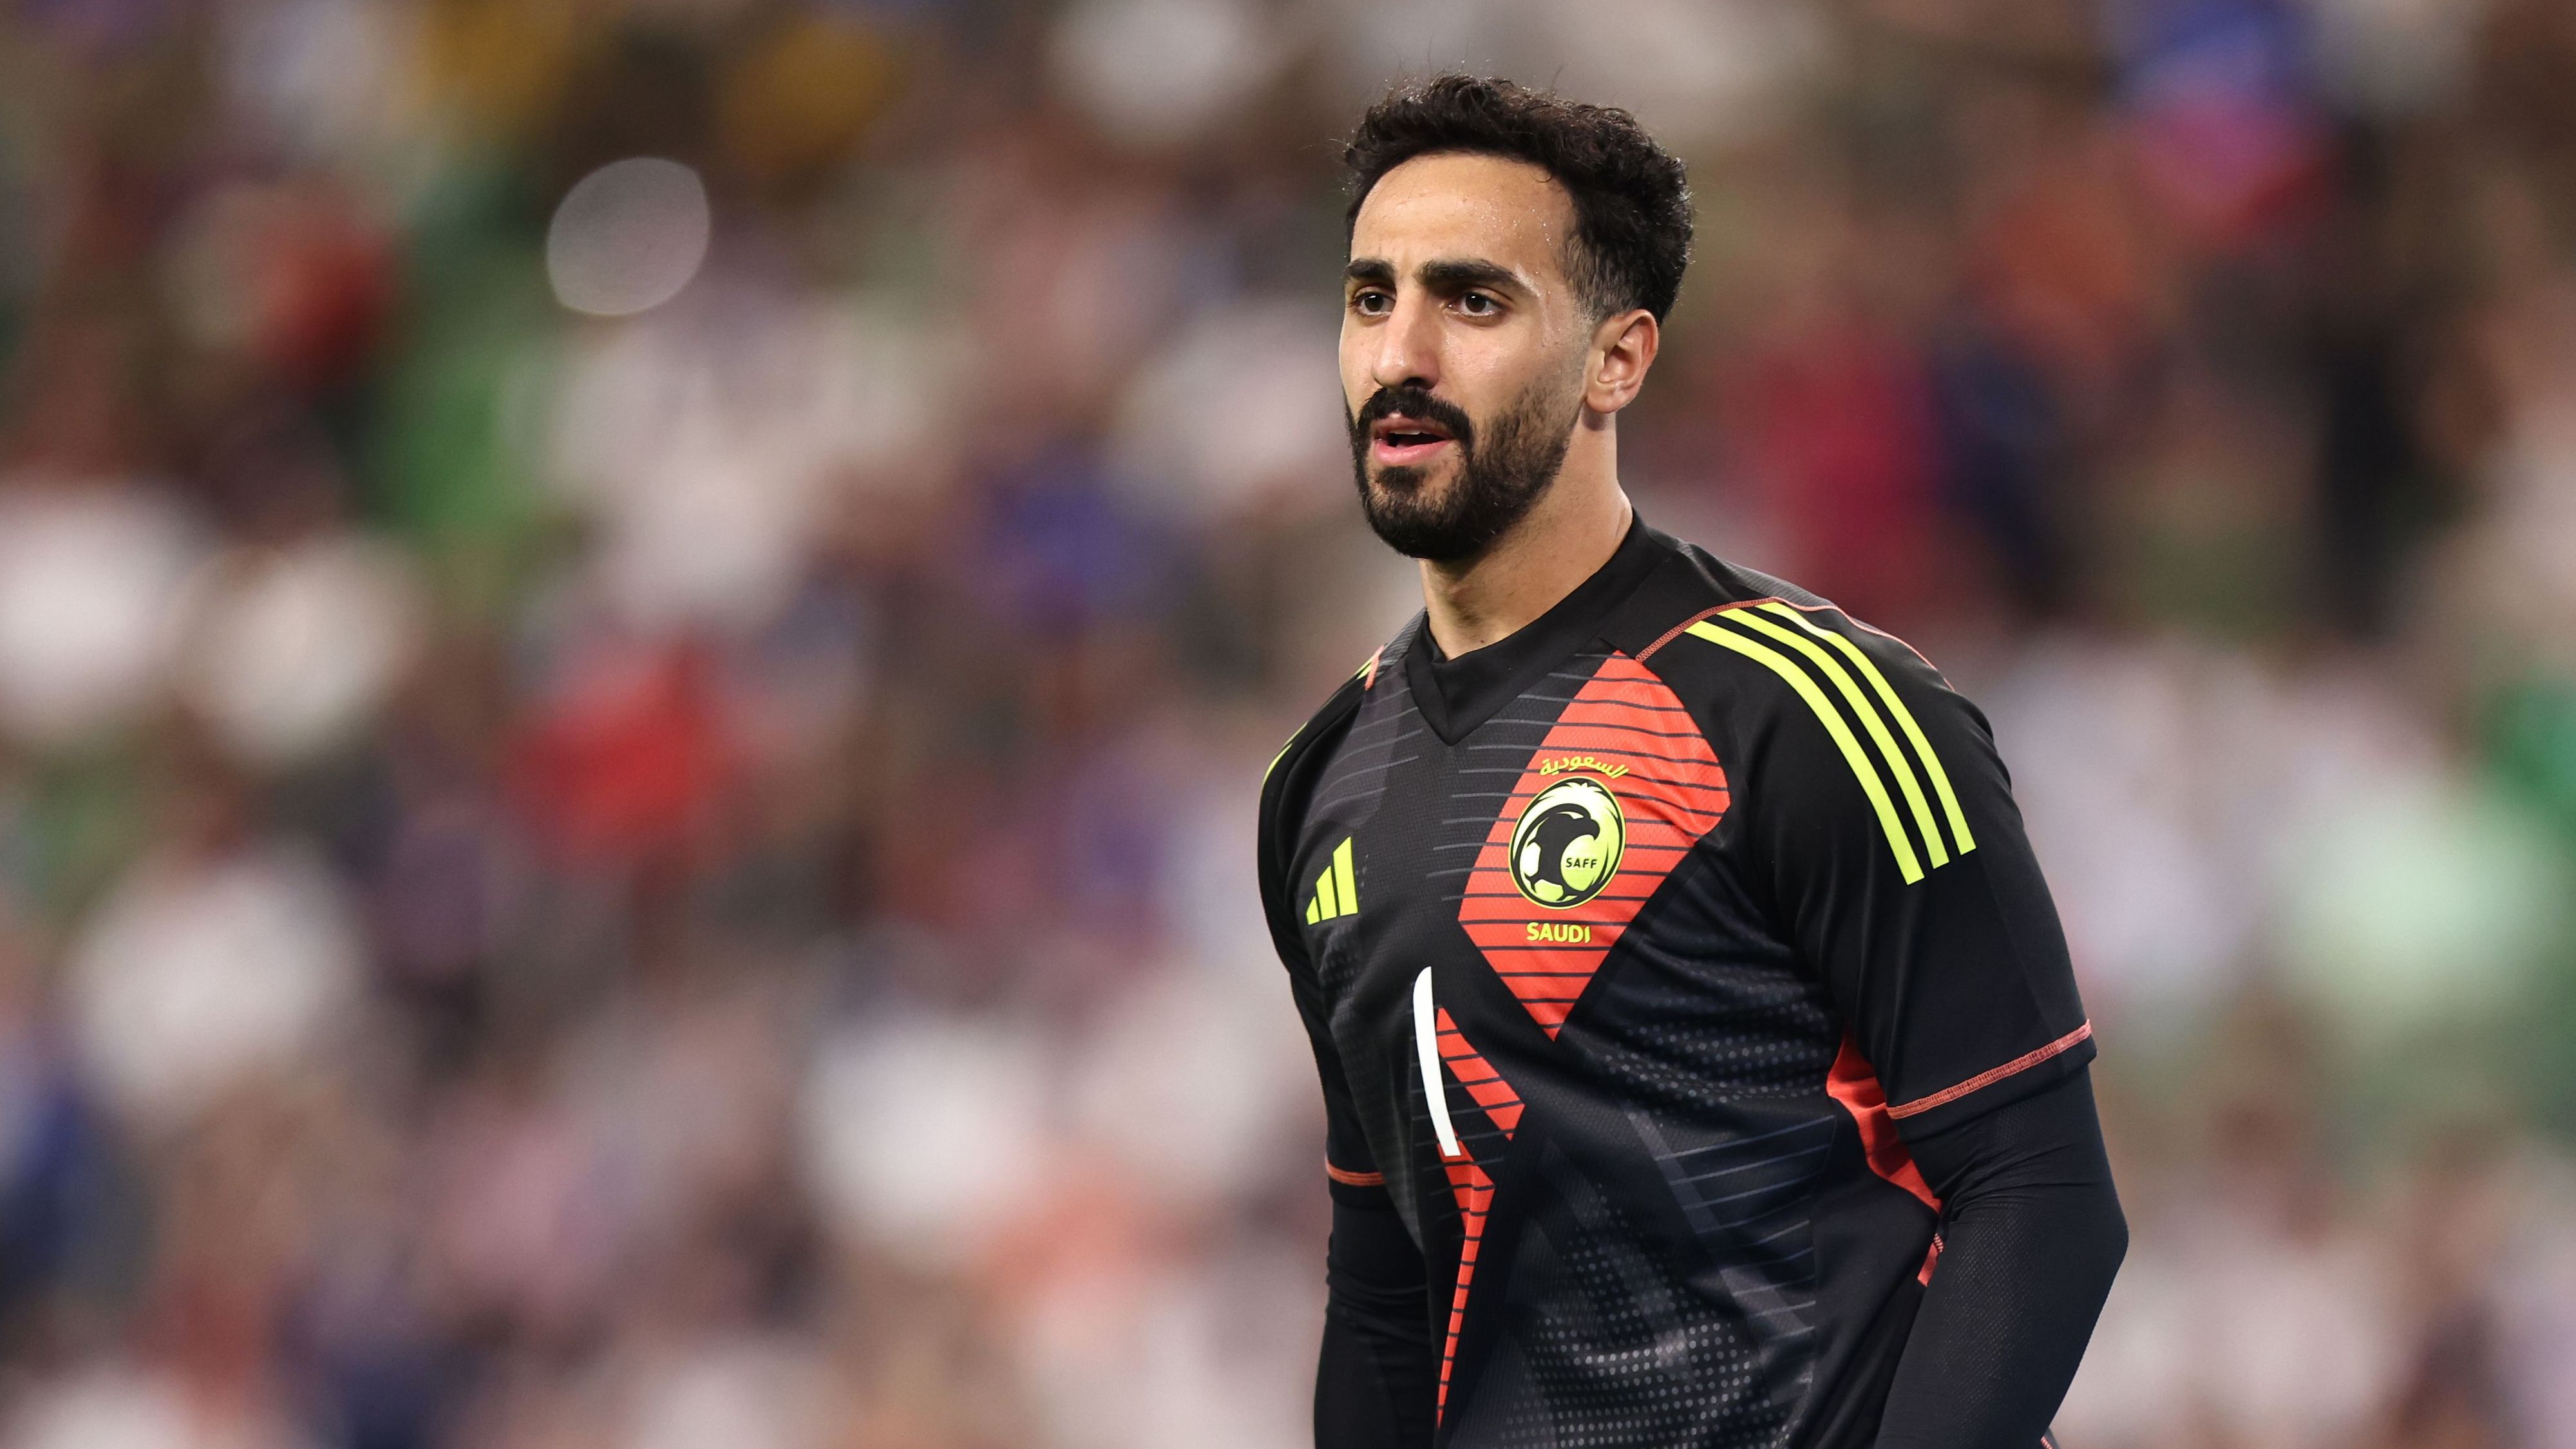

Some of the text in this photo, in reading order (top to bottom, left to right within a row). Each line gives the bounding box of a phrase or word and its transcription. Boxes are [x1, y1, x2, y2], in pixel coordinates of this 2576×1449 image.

[1540, 756, 1629, 779] السعودية
[1566, 858, 1597, 869] SAFF
[1526, 922, 1591, 943] SAUDI
[1413, 966, 1461, 1156] 1
